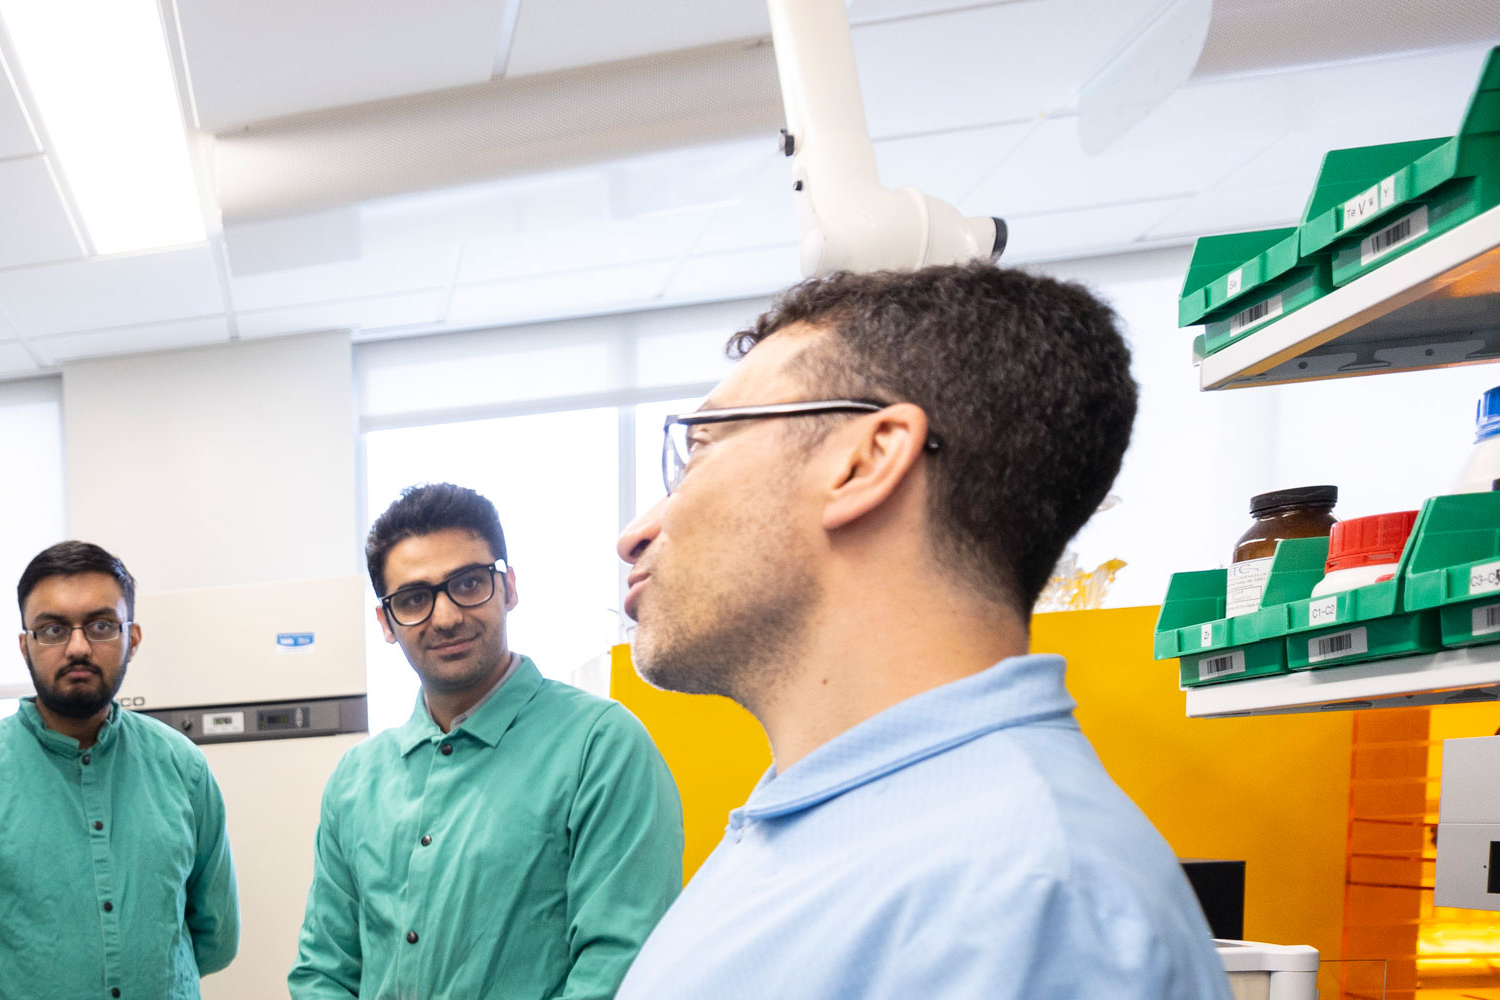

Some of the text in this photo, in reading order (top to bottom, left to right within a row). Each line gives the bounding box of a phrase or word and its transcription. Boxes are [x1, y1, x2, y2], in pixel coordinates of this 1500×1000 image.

[1358, 199, 1366, 216] V
[1312, 605, 1335, 619] C1-C2
[117, 696, 145, 707] CO
